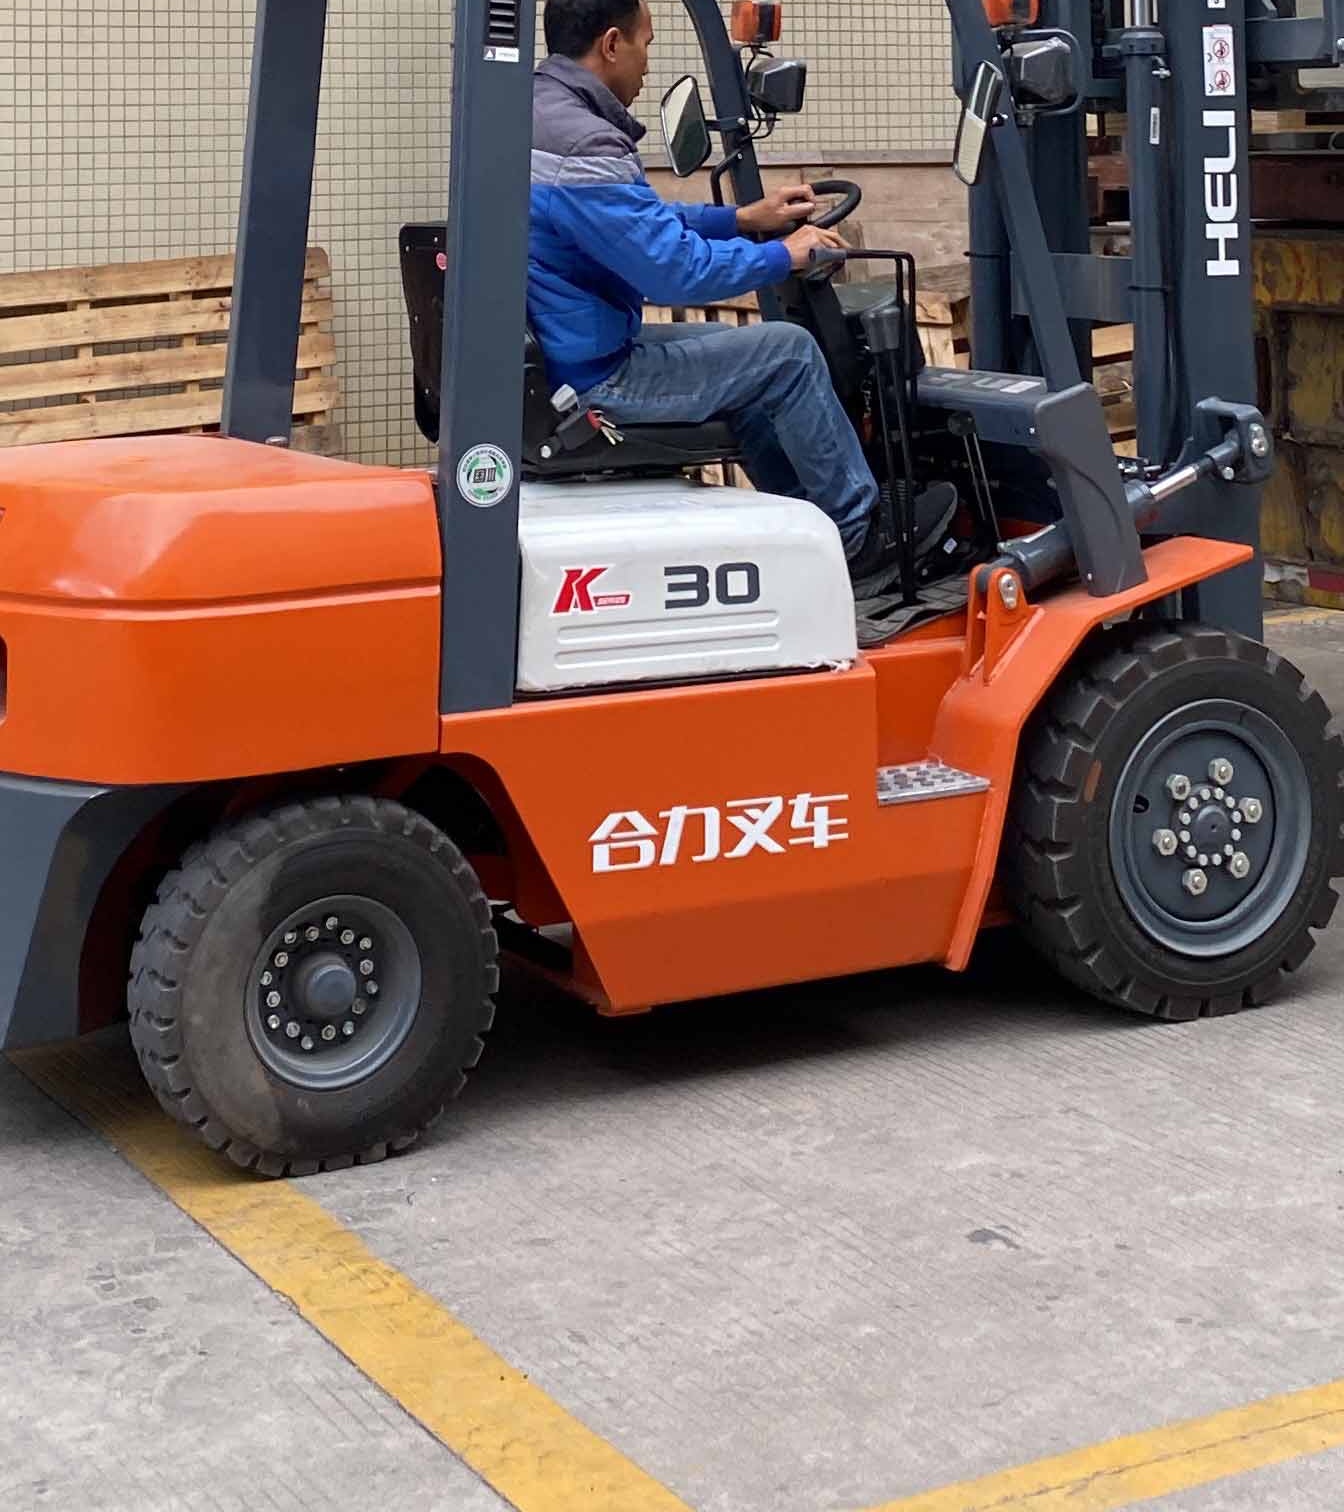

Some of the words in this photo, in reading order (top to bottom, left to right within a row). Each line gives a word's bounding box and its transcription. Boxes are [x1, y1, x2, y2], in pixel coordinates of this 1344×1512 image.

[1203, 110, 1240, 276] HELI
[552, 567, 609, 614] K
[663, 561, 761, 610] 30
[587, 792, 849, 873] 合力叉车
